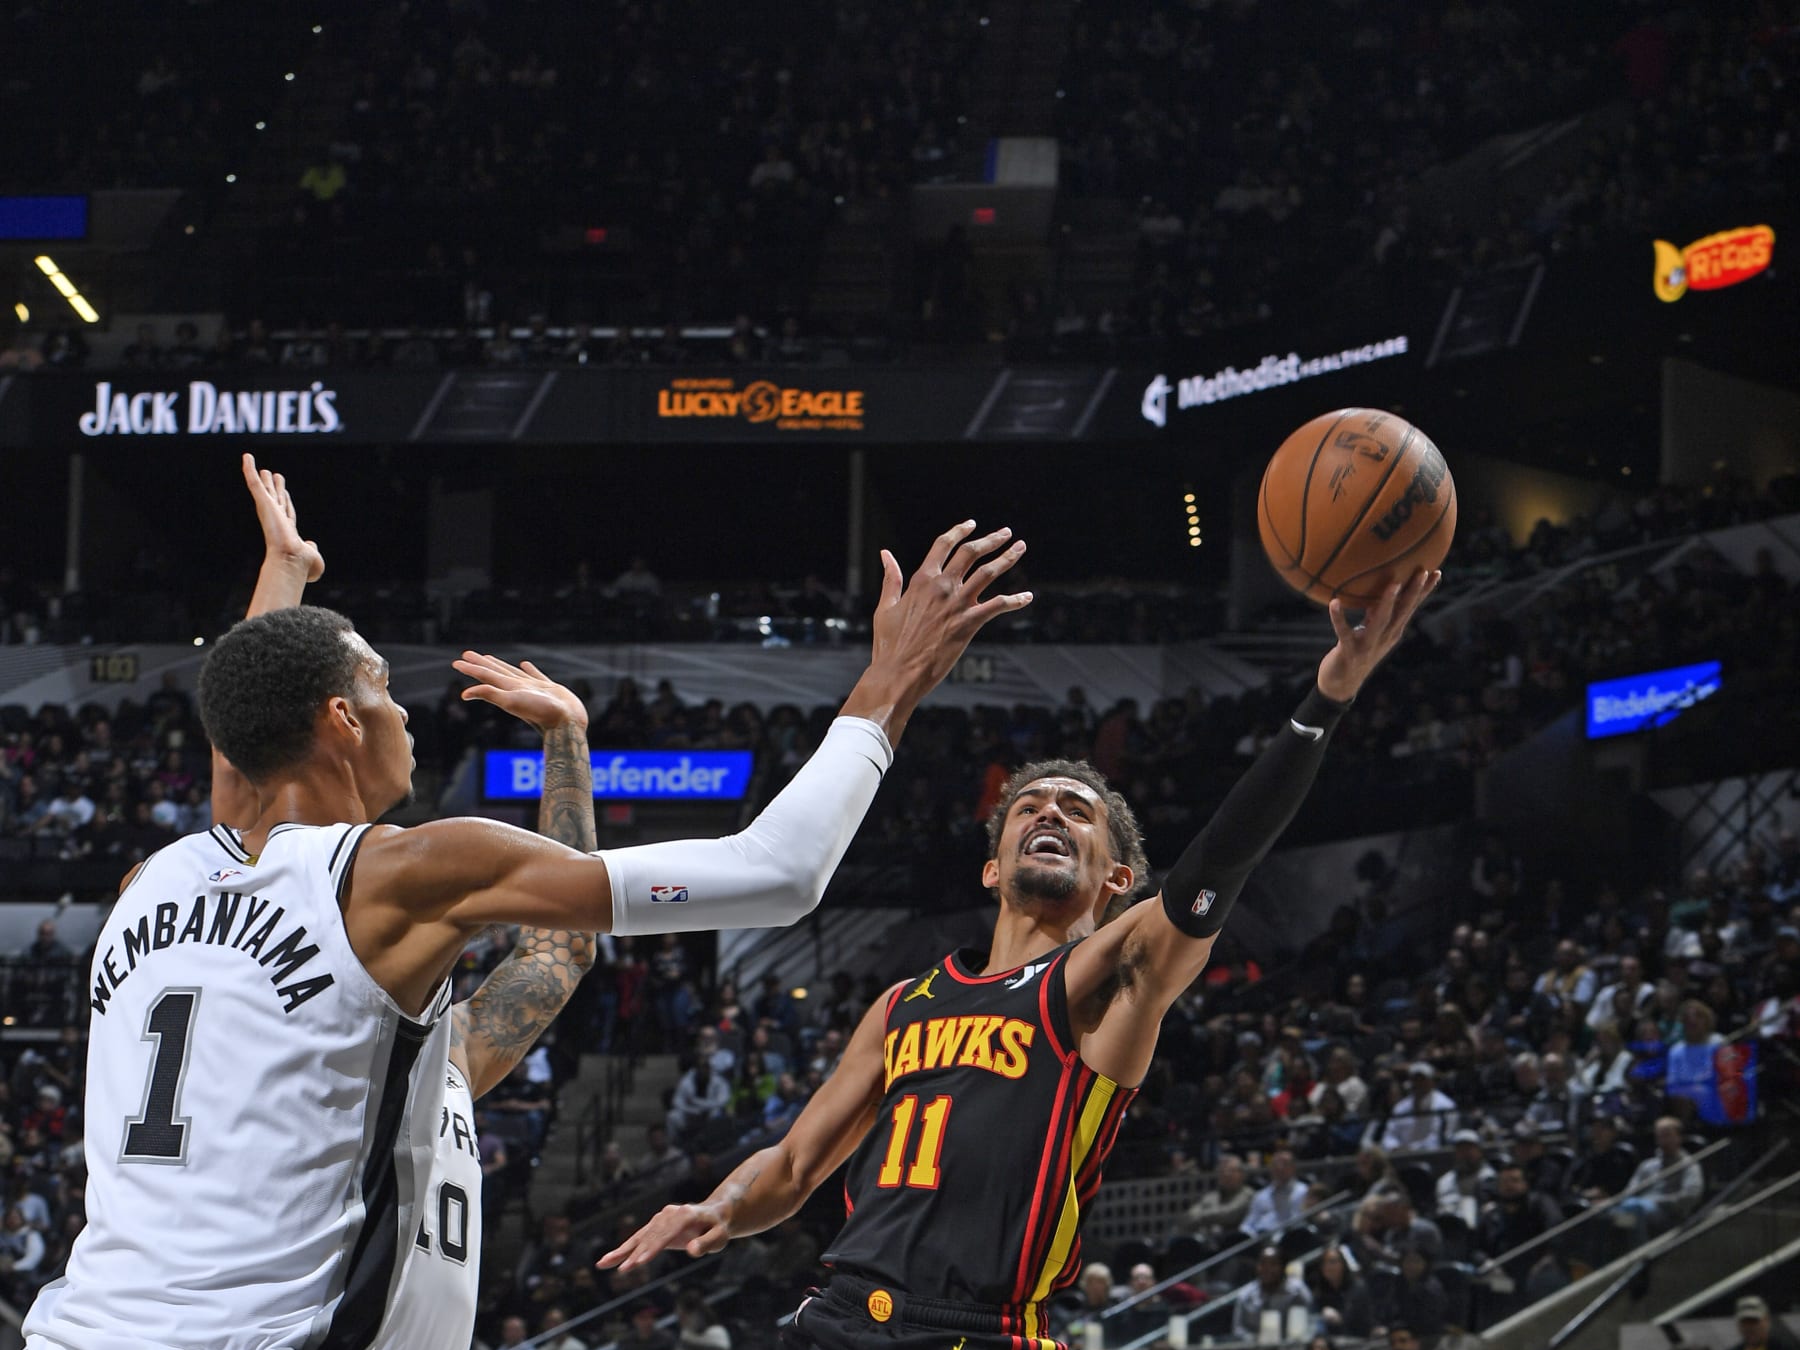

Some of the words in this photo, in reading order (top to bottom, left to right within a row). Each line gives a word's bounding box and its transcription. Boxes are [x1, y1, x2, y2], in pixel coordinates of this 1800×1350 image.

[79, 381, 178, 436] JACK
[188, 380, 340, 434] DANIEL'S
[658, 389, 743, 417] LUCKY
[781, 389, 864, 416] EAGLE
[1177, 352, 1299, 410] Methodist
[512, 757, 728, 792] Biefender
[91, 891, 335, 1016] WEMBANYAMA
[117, 986, 203, 1167] 1
[877, 1095, 953, 1190] 11
[871, 1298, 889, 1315] ATL
